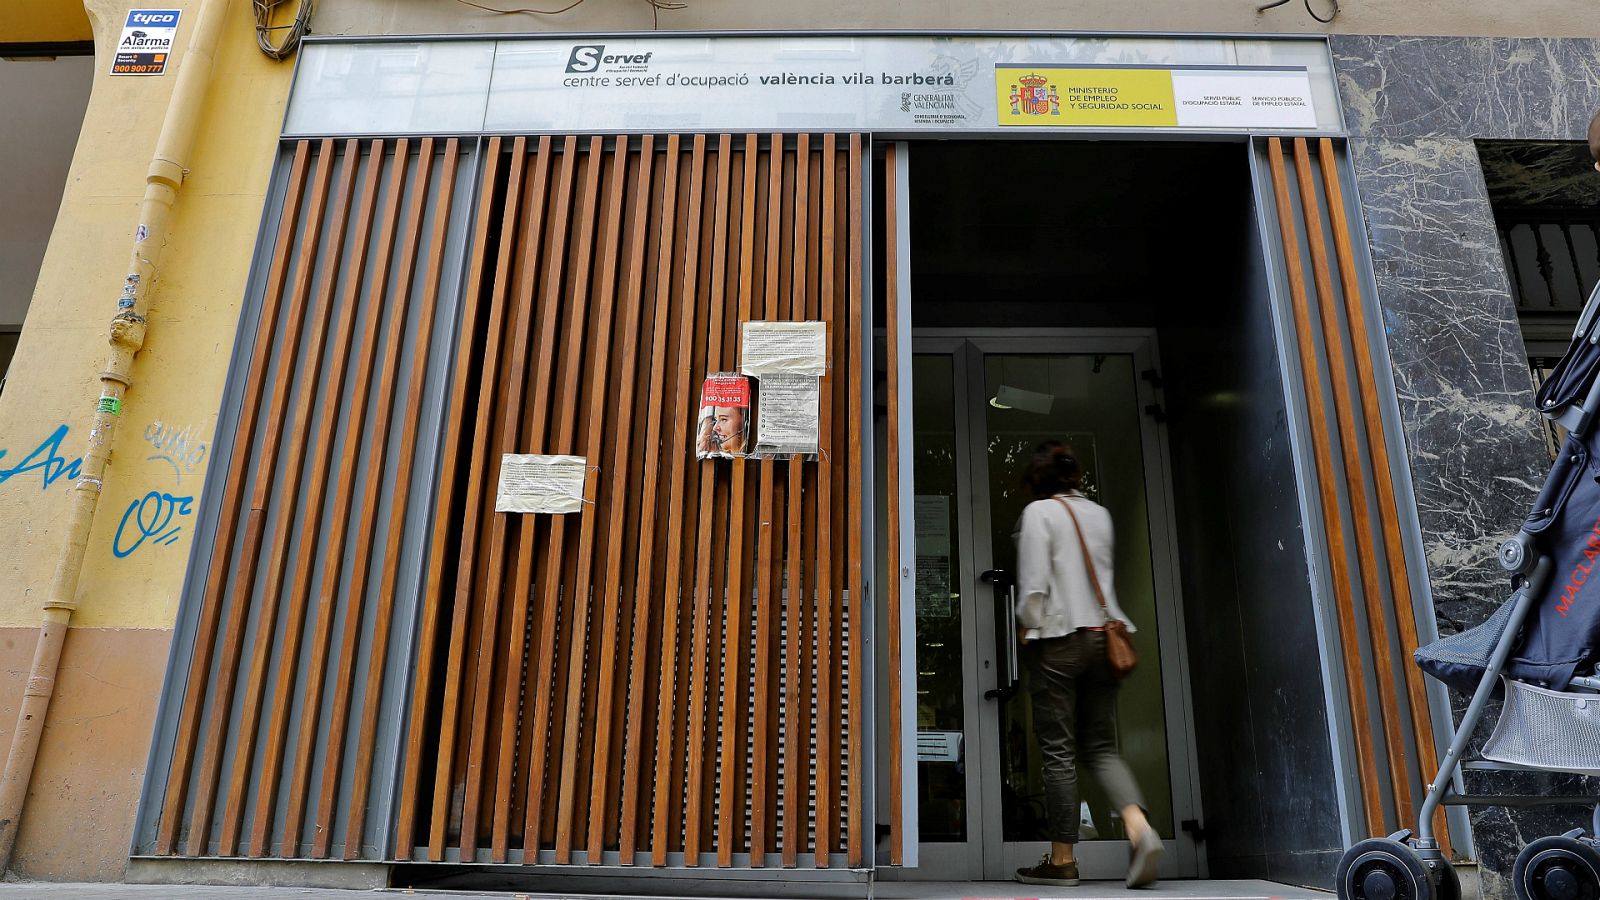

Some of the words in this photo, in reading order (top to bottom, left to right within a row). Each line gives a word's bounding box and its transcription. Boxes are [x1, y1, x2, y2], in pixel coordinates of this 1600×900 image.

[133, 13, 175, 25] tyco
[122, 36, 170, 45] Alarma
[565, 45, 653, 73] Servef
[131, 65, 147, 73] 900
[147, 65, 163, 73] 777
[563, 75, 610, 87] centre
[615, 73, 661, 87] servef
[666, 73, 749, 89] d'ocupació
[760, 73, 835, 85] valència
[842, 73, 874, 85] vila
[882, 73, 954, 86] barberá
